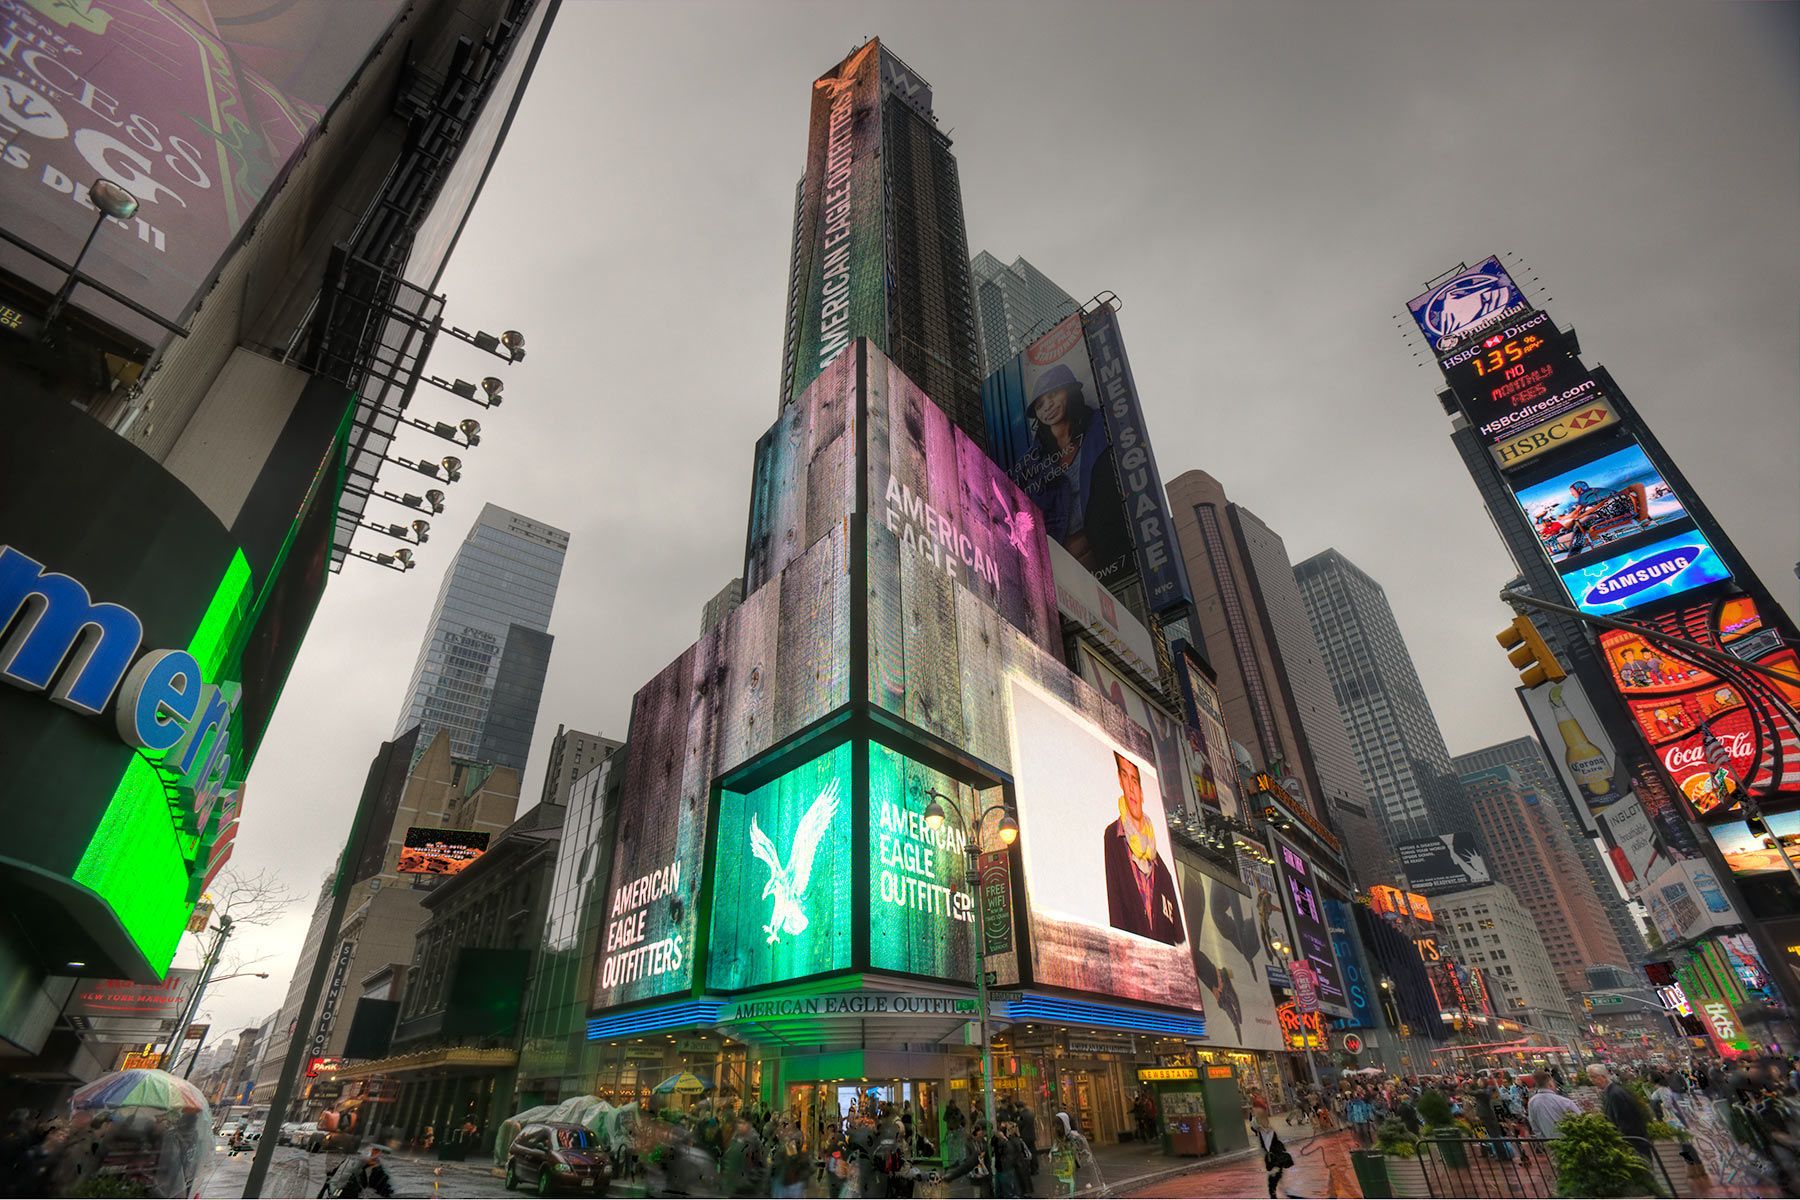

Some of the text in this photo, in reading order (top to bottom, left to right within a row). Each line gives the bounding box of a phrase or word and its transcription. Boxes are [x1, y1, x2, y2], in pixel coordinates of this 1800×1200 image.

[888, 59, 921, 98] W
[827, 91, 853, 189] OUTFITTERS
[42, 164, 130, 230] DE.
[135, 216, 166, 253] 11
[825, 181, 852, 250] EAGLE
[1442, 313, 1549, 370] HSBC Direct
[1456, 302, 1526, 341] Prudential
[1505, 363, 1526, 381] NO
[1480, 379, 1596, 436] HSBCdirect.com
[1020, 442, 1075, 481] Windows
[1075, 433, 1084, 447] 7
[1023, 447, 1040, 465] PC
[1088, 323, 1168, 571] TIMES SQUARE
[1496, 422, 1569, 463] HSBC
[885, 474, 1000, 592] AMERICAN
[886, 506, 957, 578] EAGLE
[1154, 582, 1174, 596] NYC
[1595, 556, 1690, 595] SAMSUNG
[1571, 756, 1605, 772] Corona
[880, 801, 967, 858] AMERICAN
[1608, 803, 1641, 828] INGLOT
[879, 831, 935, 879] EAGLE
[611, 859, 681, 918] AMERICAN
[986, 882, 1006, 897] FREE
[607, 909, 648, 953] EAGLE
[602, 934, 684, 990] OUTFITTERS
[311, 945, 351, 1056] SCIENTOLOG
[734, 997, 819, 1020] AMERICAN
[824, 994, 888, 1014] EAGLE
[991, 991, 1023, 1001] BROADWAY
[1704, 1002, 1737, 1041] tkts
[1141, 1069, 1195, 1079] NEWSSTAND
